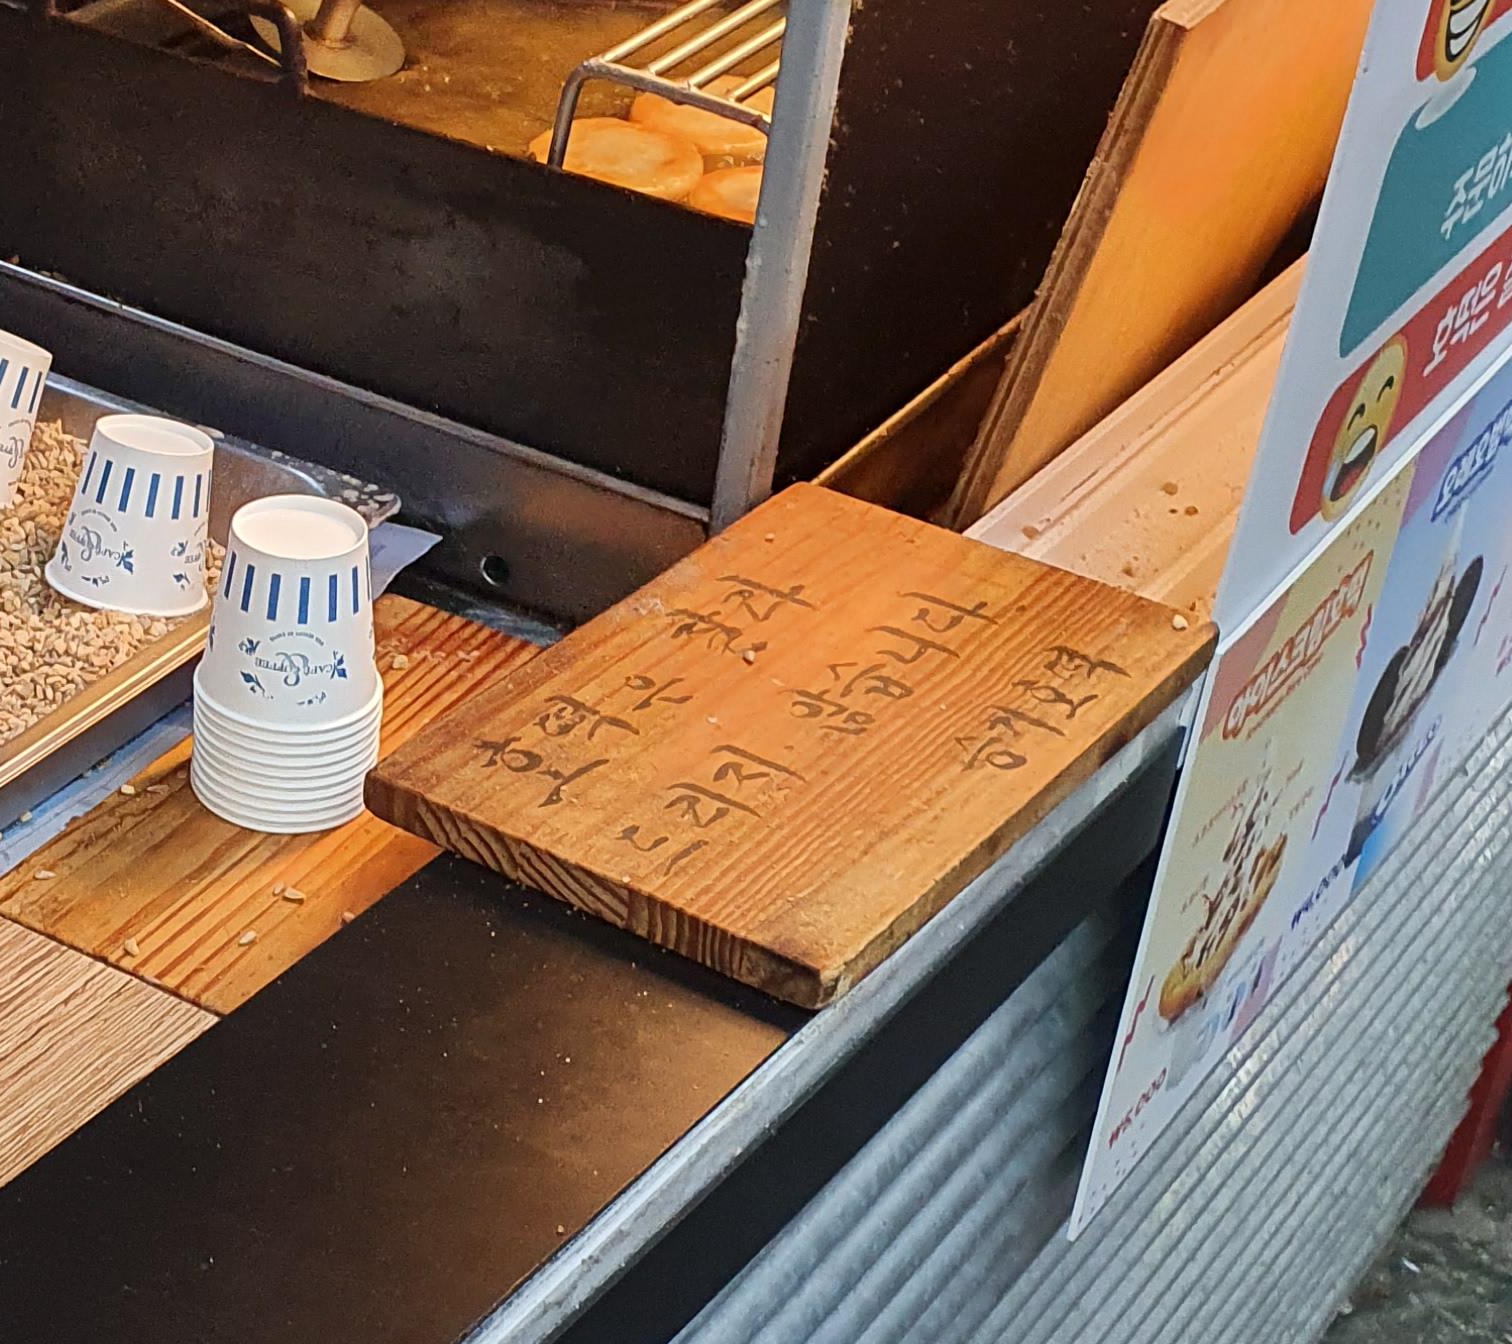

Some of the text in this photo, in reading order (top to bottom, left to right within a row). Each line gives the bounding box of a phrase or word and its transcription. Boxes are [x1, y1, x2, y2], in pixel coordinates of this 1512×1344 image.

[1422, 261, 1504, 377] 호떡은
[474, 575, 817, 809] 호떡은 잘라
[617, 592, 999, 876] 드리지 않습니다
[1225, 552, 1373, 737] 아이스크림호떡
